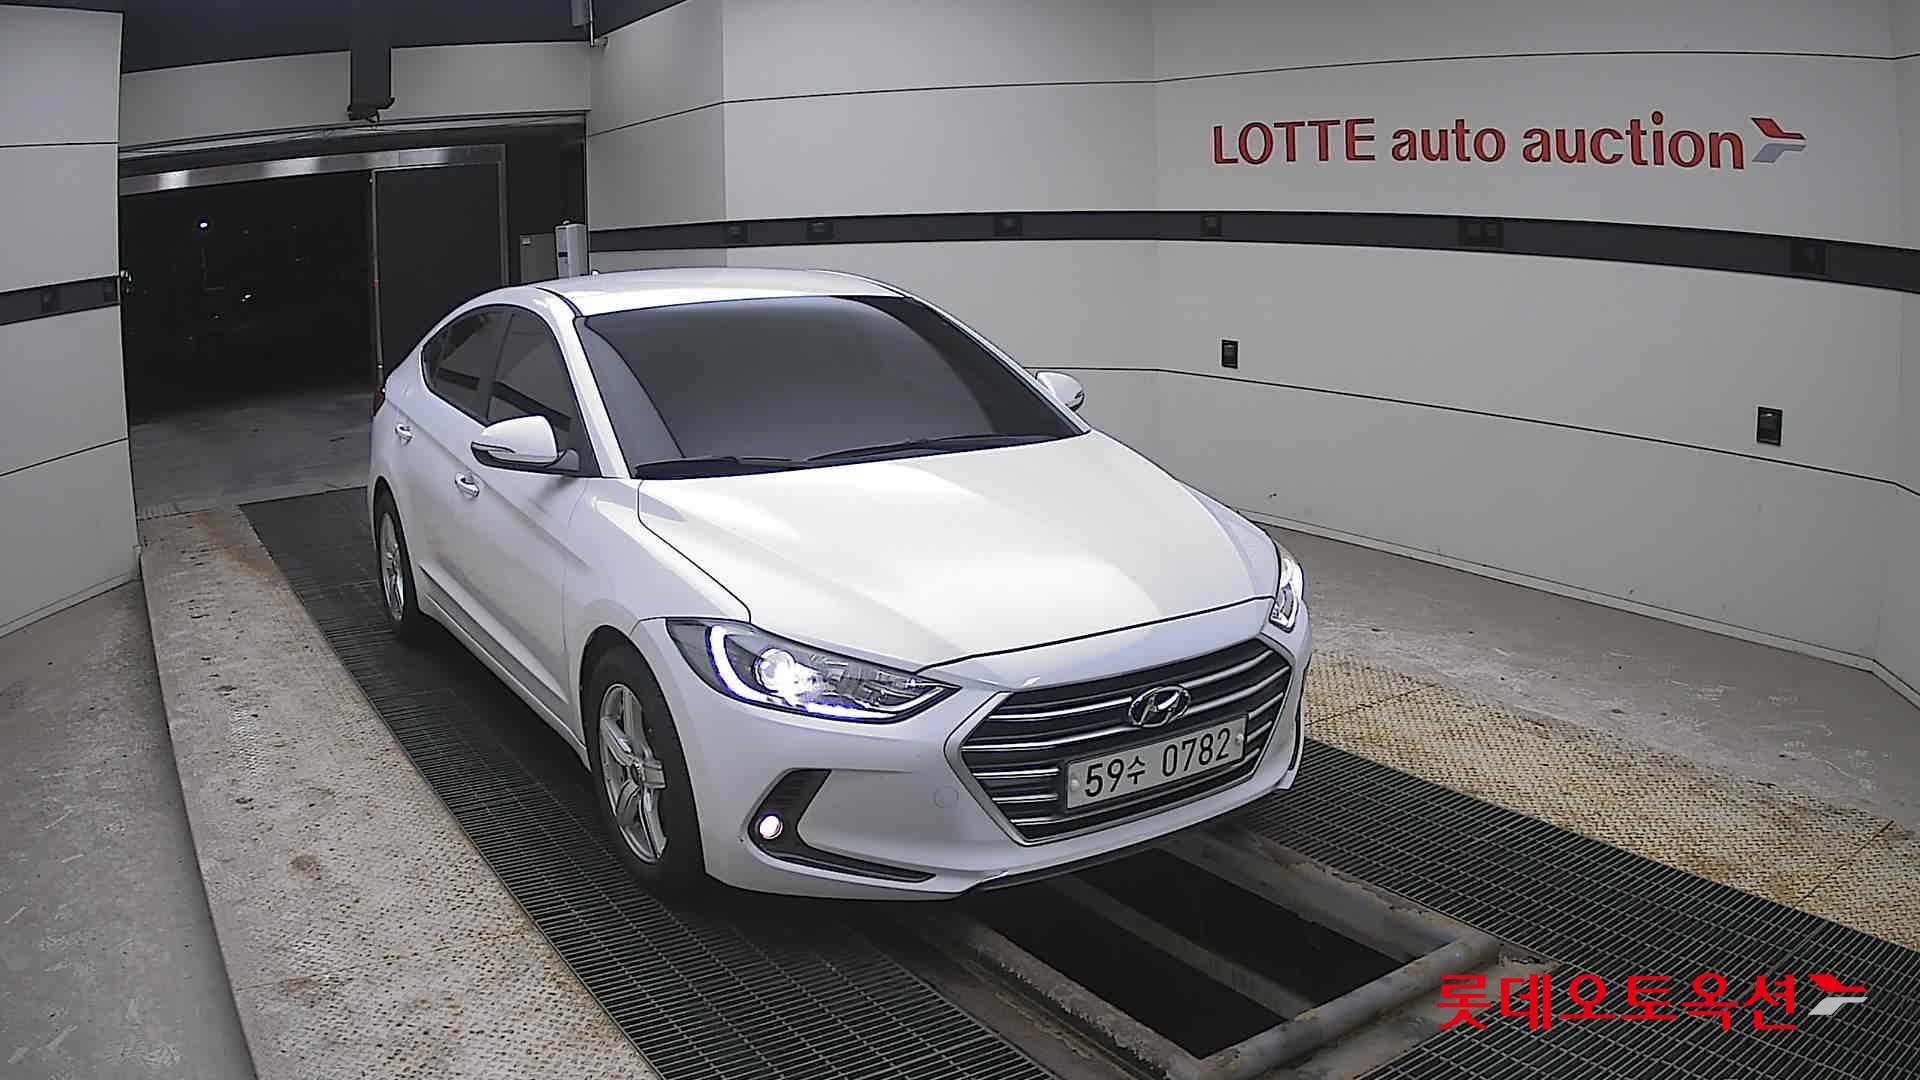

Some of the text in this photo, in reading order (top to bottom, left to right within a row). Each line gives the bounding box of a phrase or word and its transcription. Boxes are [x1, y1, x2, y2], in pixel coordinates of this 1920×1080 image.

[1212, 110, 1744, 170] LOTTE auto auction
[1085, 728, 1231, 797] 59수 0782
